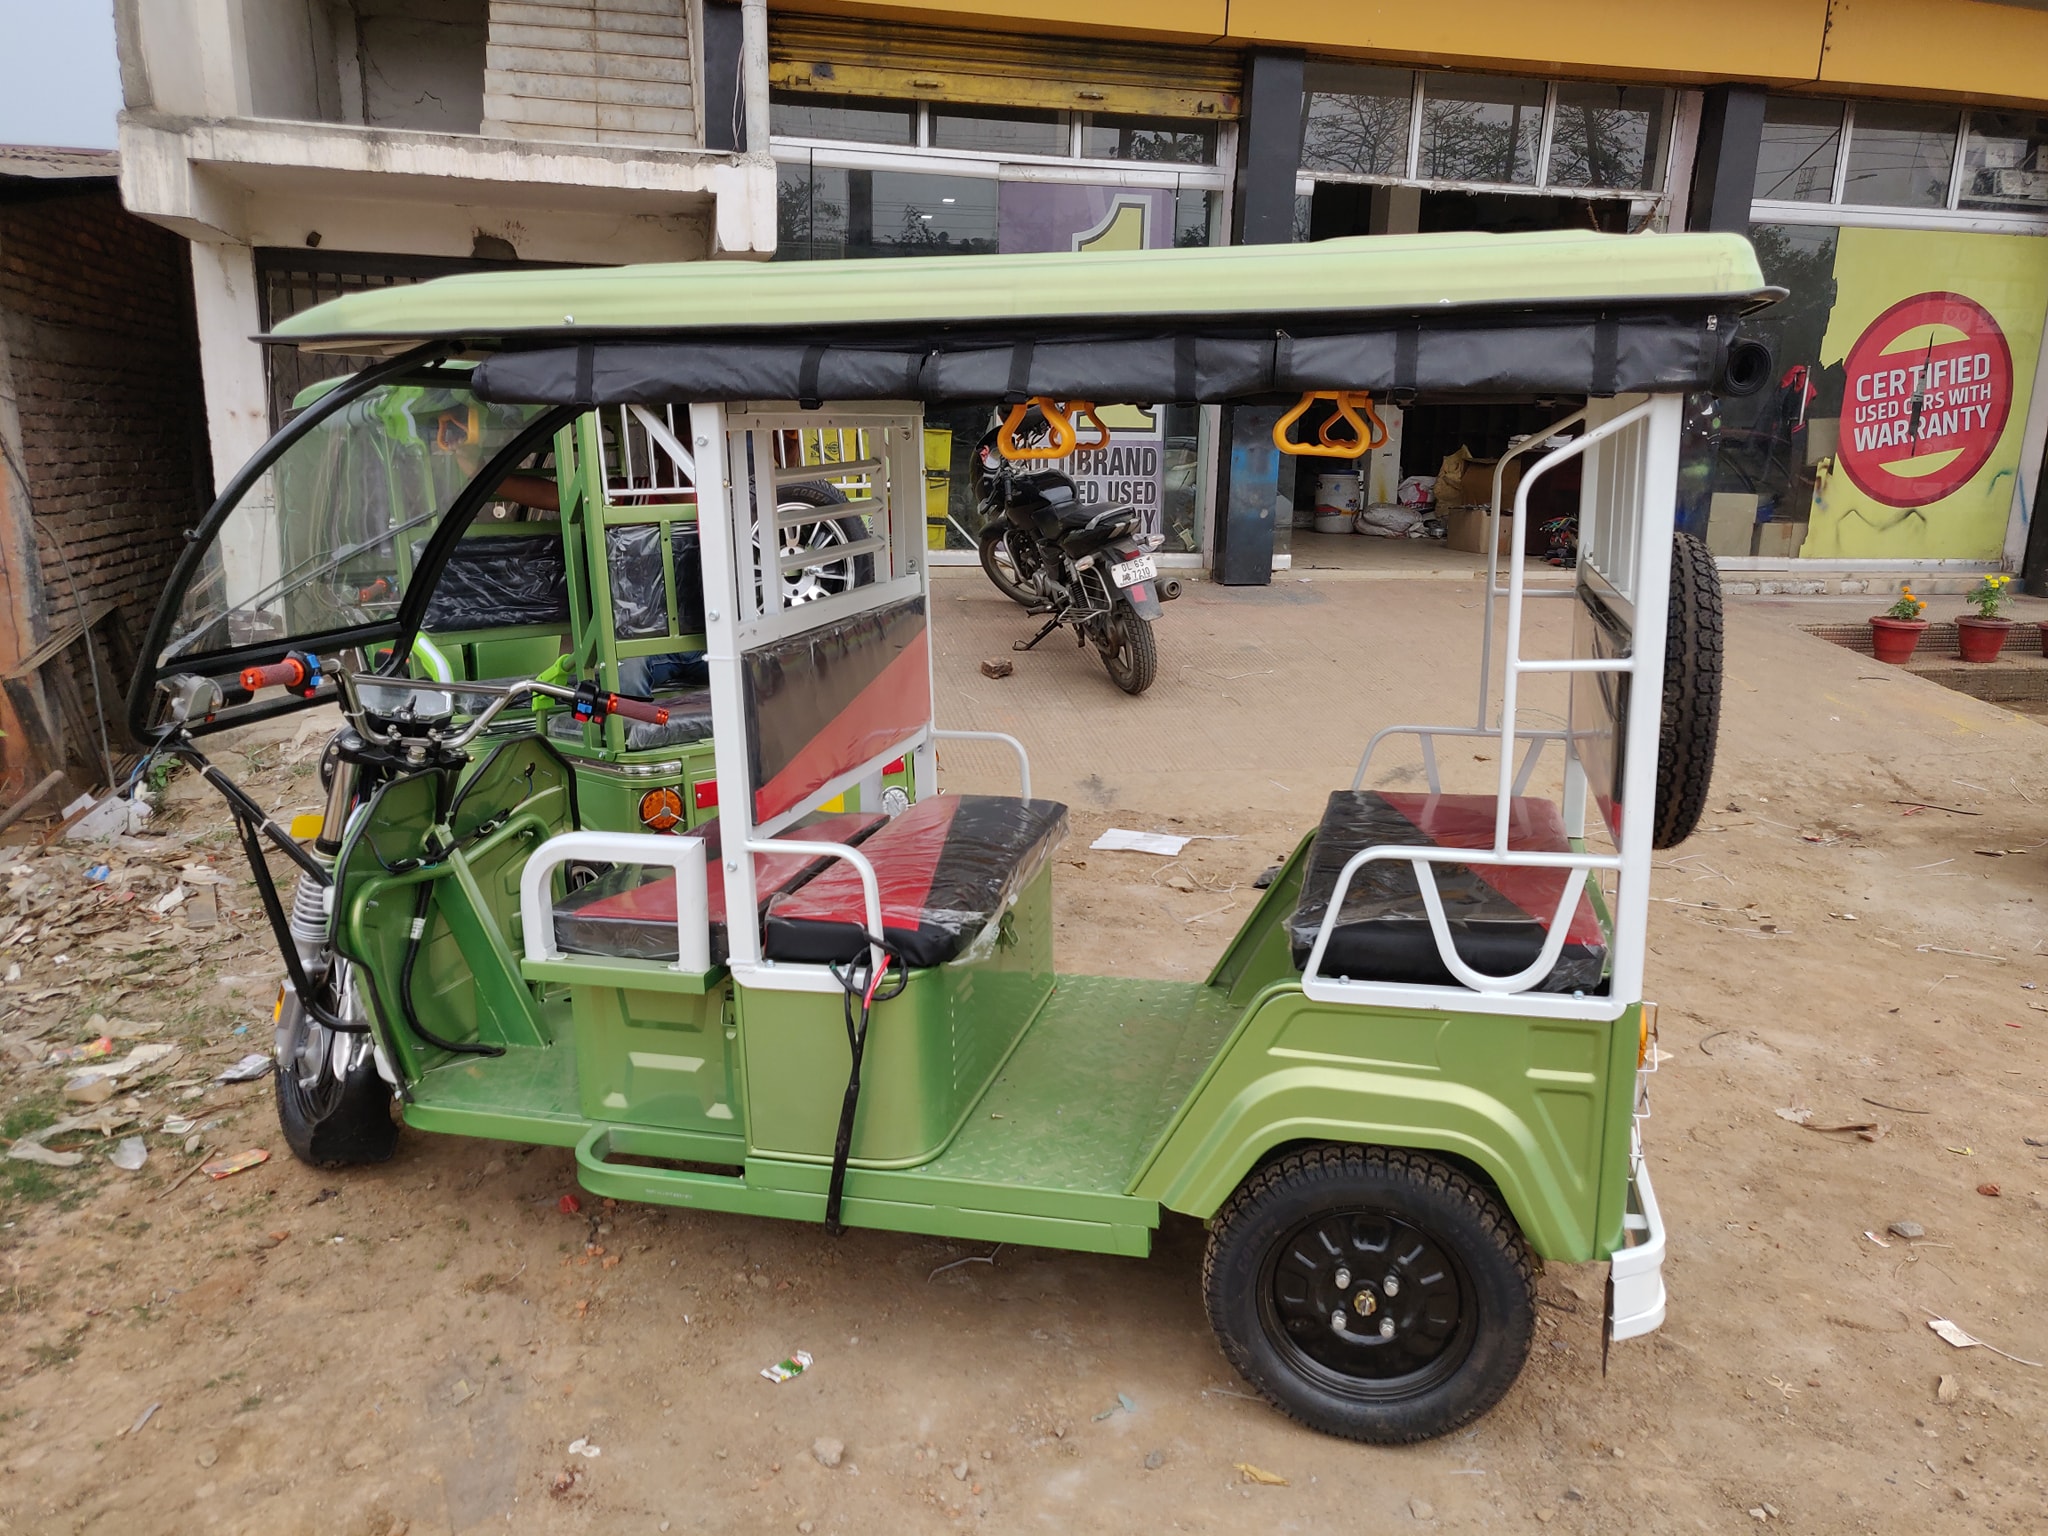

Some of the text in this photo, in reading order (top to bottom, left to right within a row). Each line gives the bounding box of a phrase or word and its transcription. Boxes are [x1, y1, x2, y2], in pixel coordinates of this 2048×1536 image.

[1856, 353, 1990, 402] CERTIFIED
[1855, 382, 1991, 424] USED CRS WITH
[1012, 446, 1157, 476] IBRAND
[1107, 481, 1157, 504] USED
